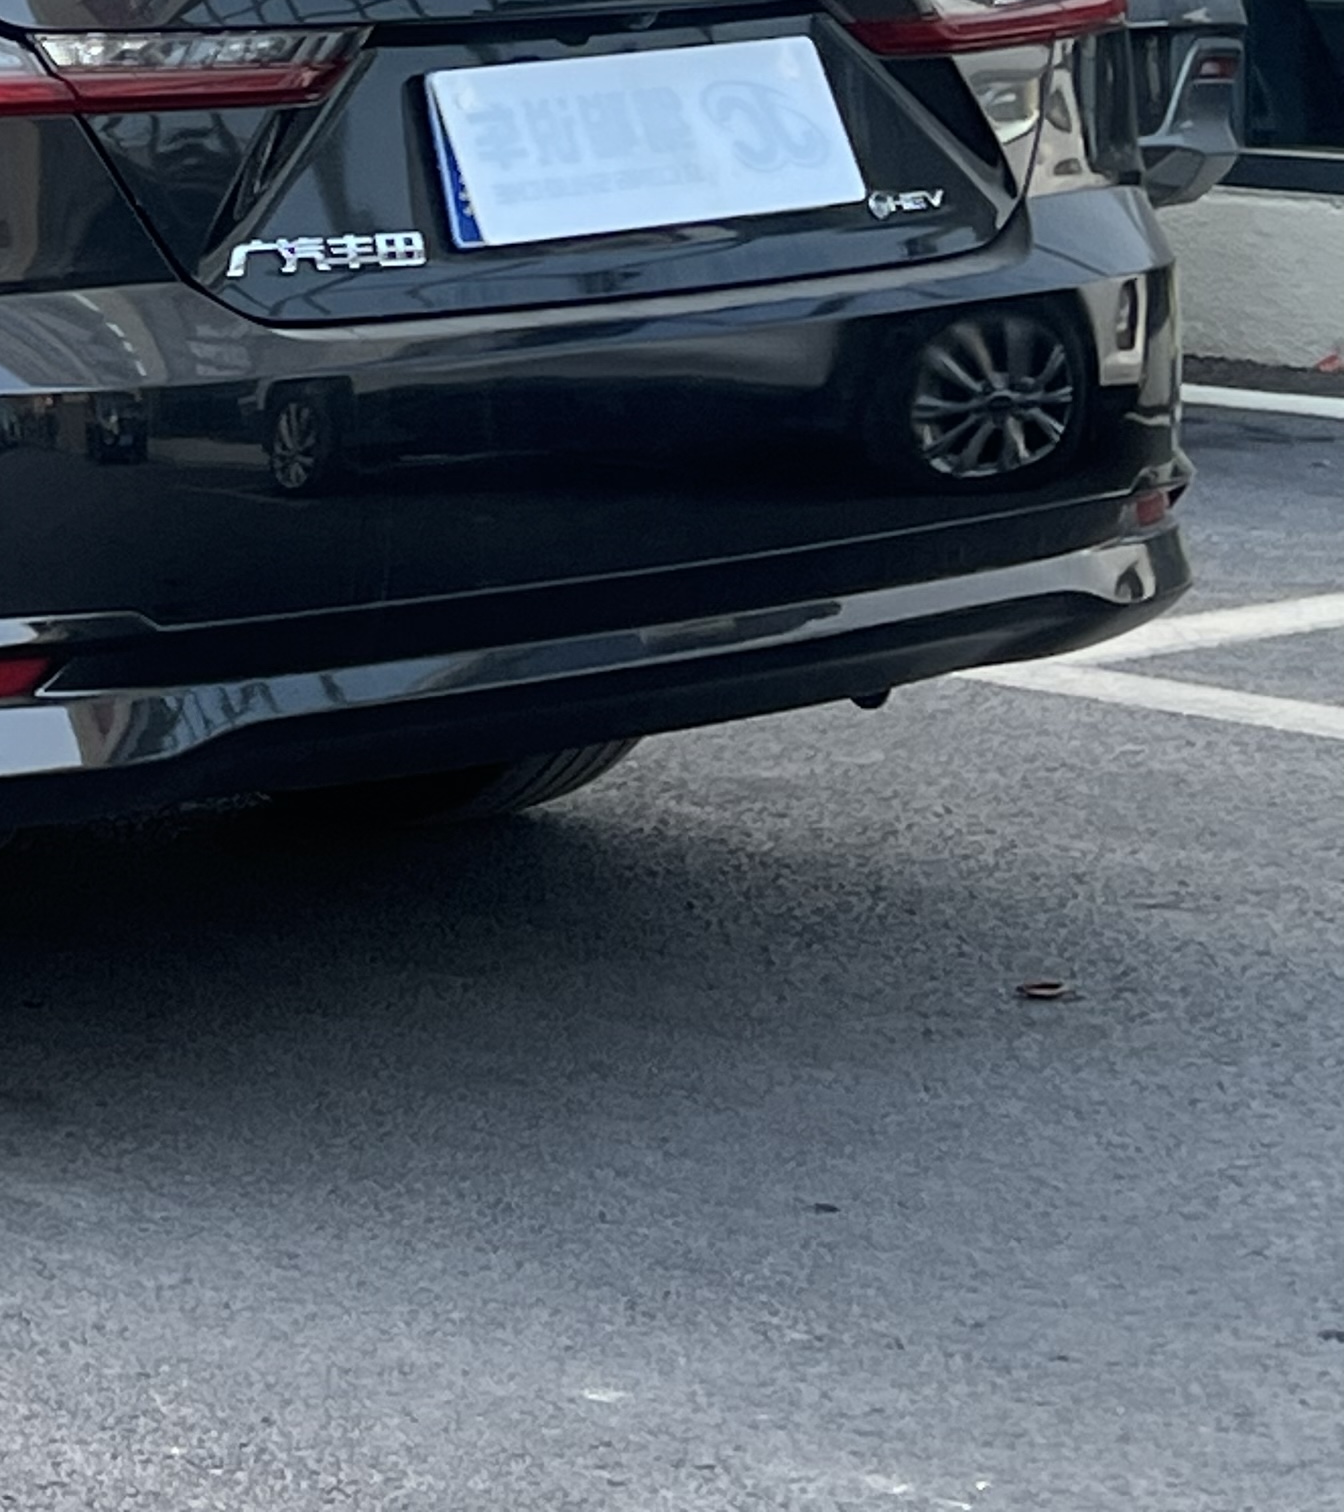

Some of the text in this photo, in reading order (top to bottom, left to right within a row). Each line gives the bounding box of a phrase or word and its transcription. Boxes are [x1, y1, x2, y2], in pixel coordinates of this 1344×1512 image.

[888, 188, 945, 213] HEV
[225, 230, 428, 278] 广汽丰田
